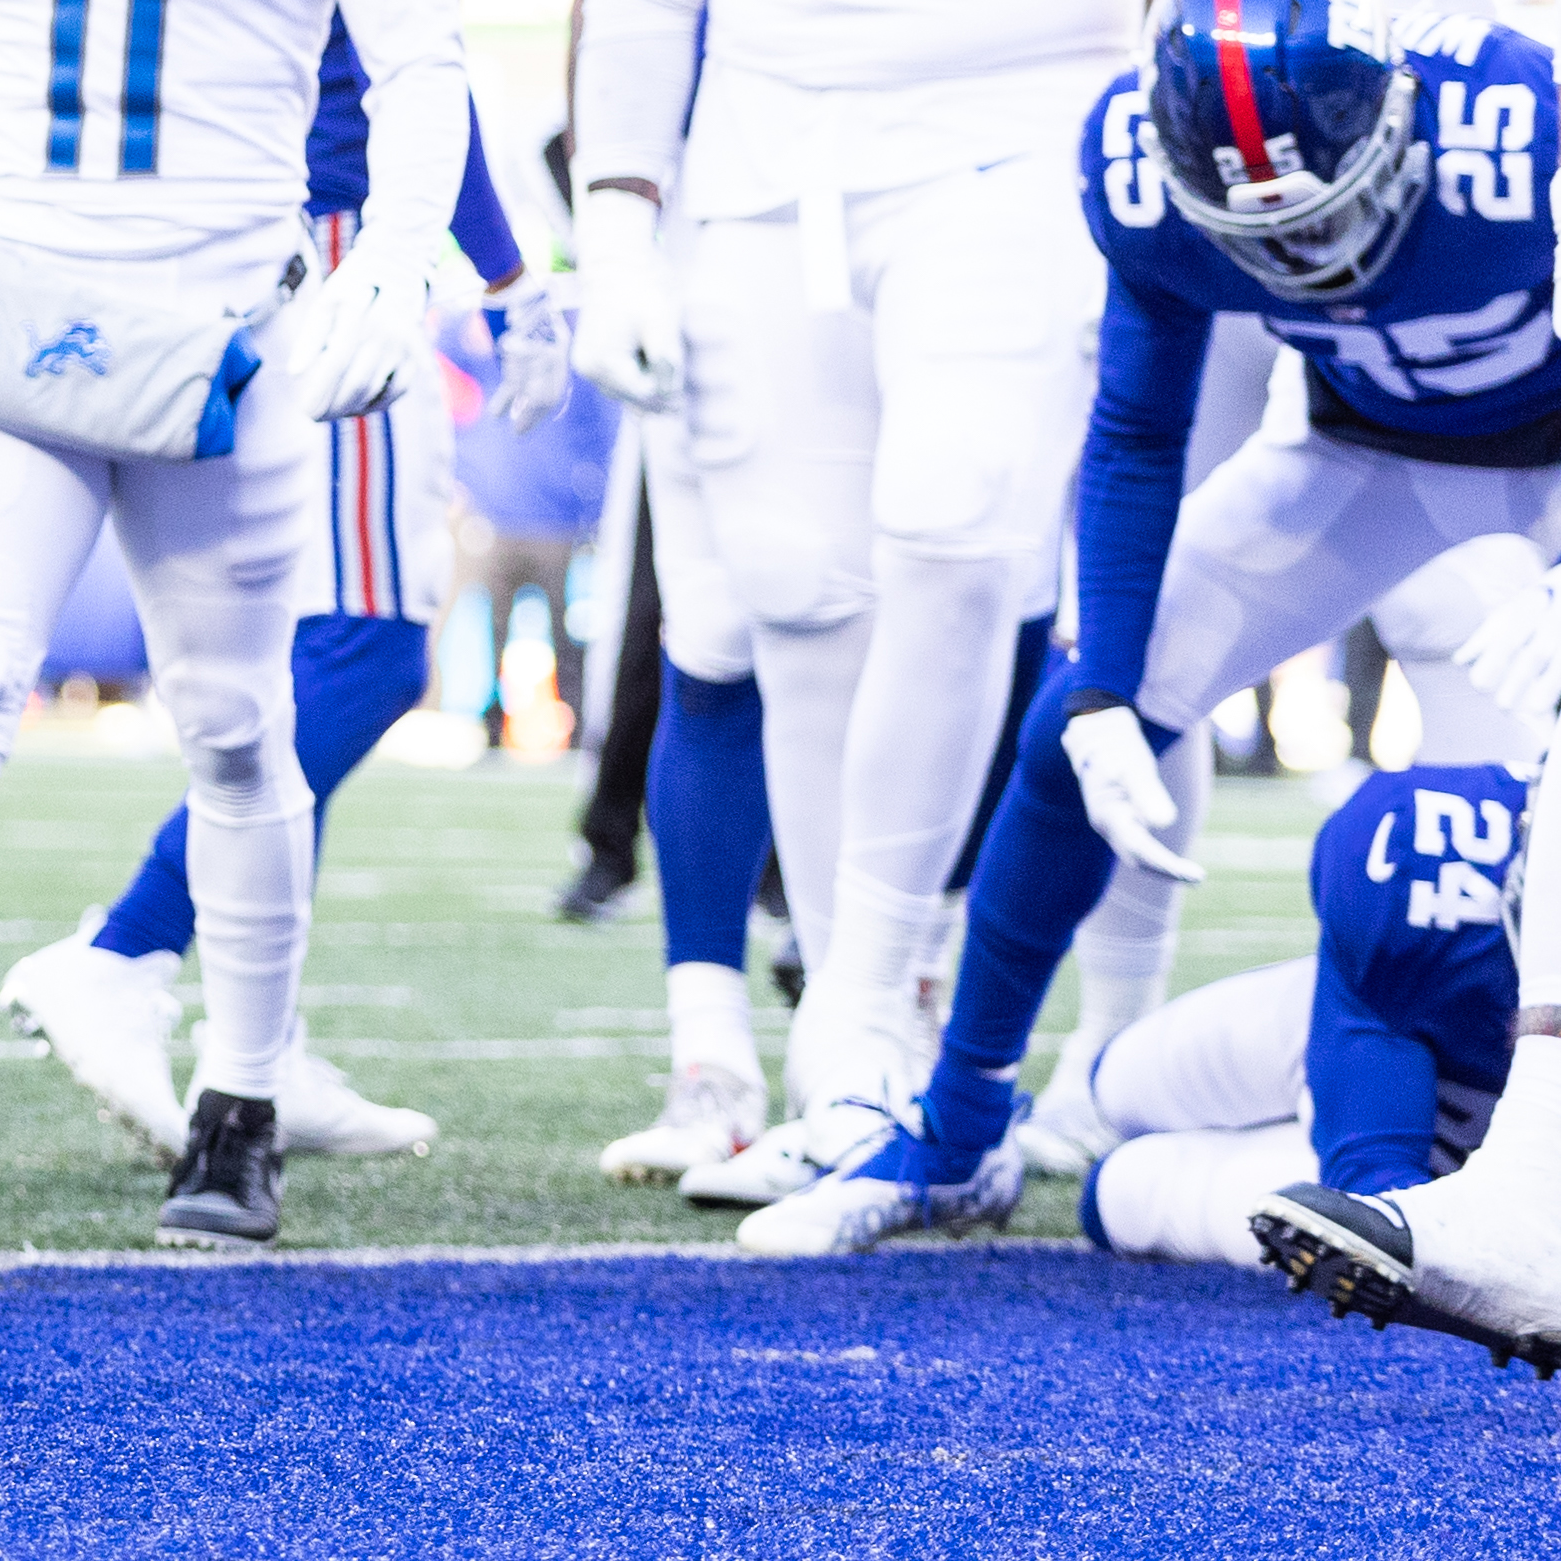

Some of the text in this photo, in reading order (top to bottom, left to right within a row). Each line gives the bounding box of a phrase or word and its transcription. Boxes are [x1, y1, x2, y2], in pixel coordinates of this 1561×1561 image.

[1211, 131, 1305, 187] 25
[1436, 80, 1537, 223] 25
[1407, 787, 1512, 932] 24
